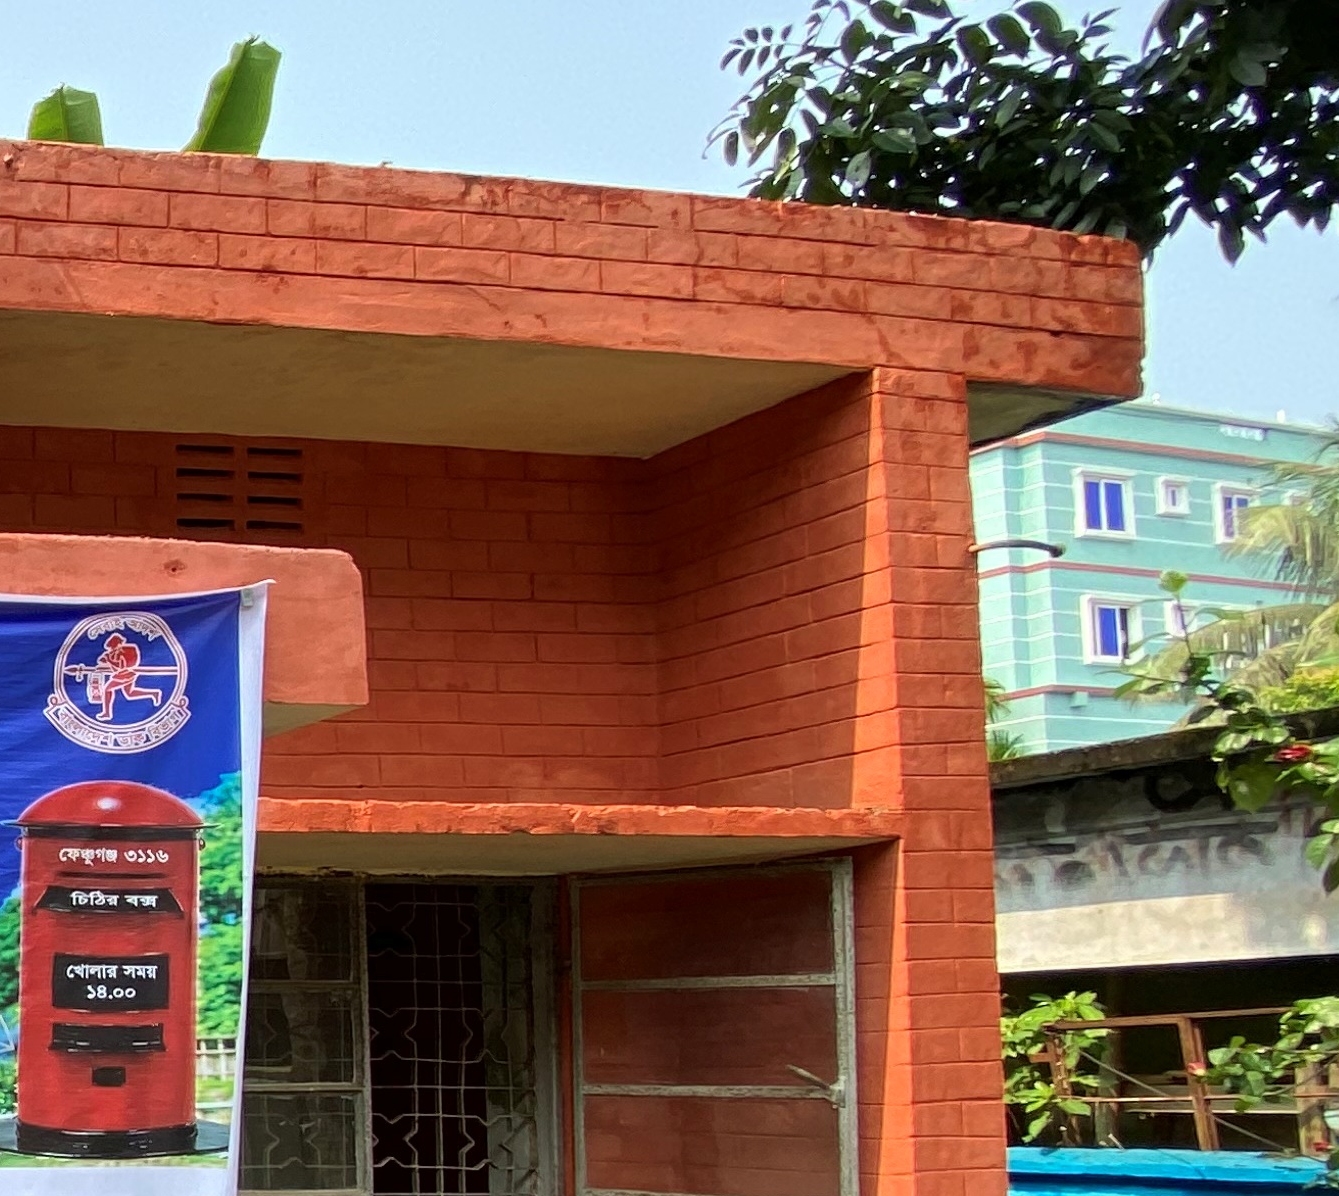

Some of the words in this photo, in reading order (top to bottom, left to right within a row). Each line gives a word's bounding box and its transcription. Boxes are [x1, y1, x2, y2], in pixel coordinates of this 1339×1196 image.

[59, 847, 118, 866] ফেঞ্চুগঞ্জ
[124, 849, 169, 864] ৩১১৬
[70, 890, 120, 907] চিঠির
[124, 894, 159, 908] বক্স
[66, 963, 118, 979] খোলার
[121, 965, 158, 980] সময়
[86, 984, 137, 1000] ১৪.০০
